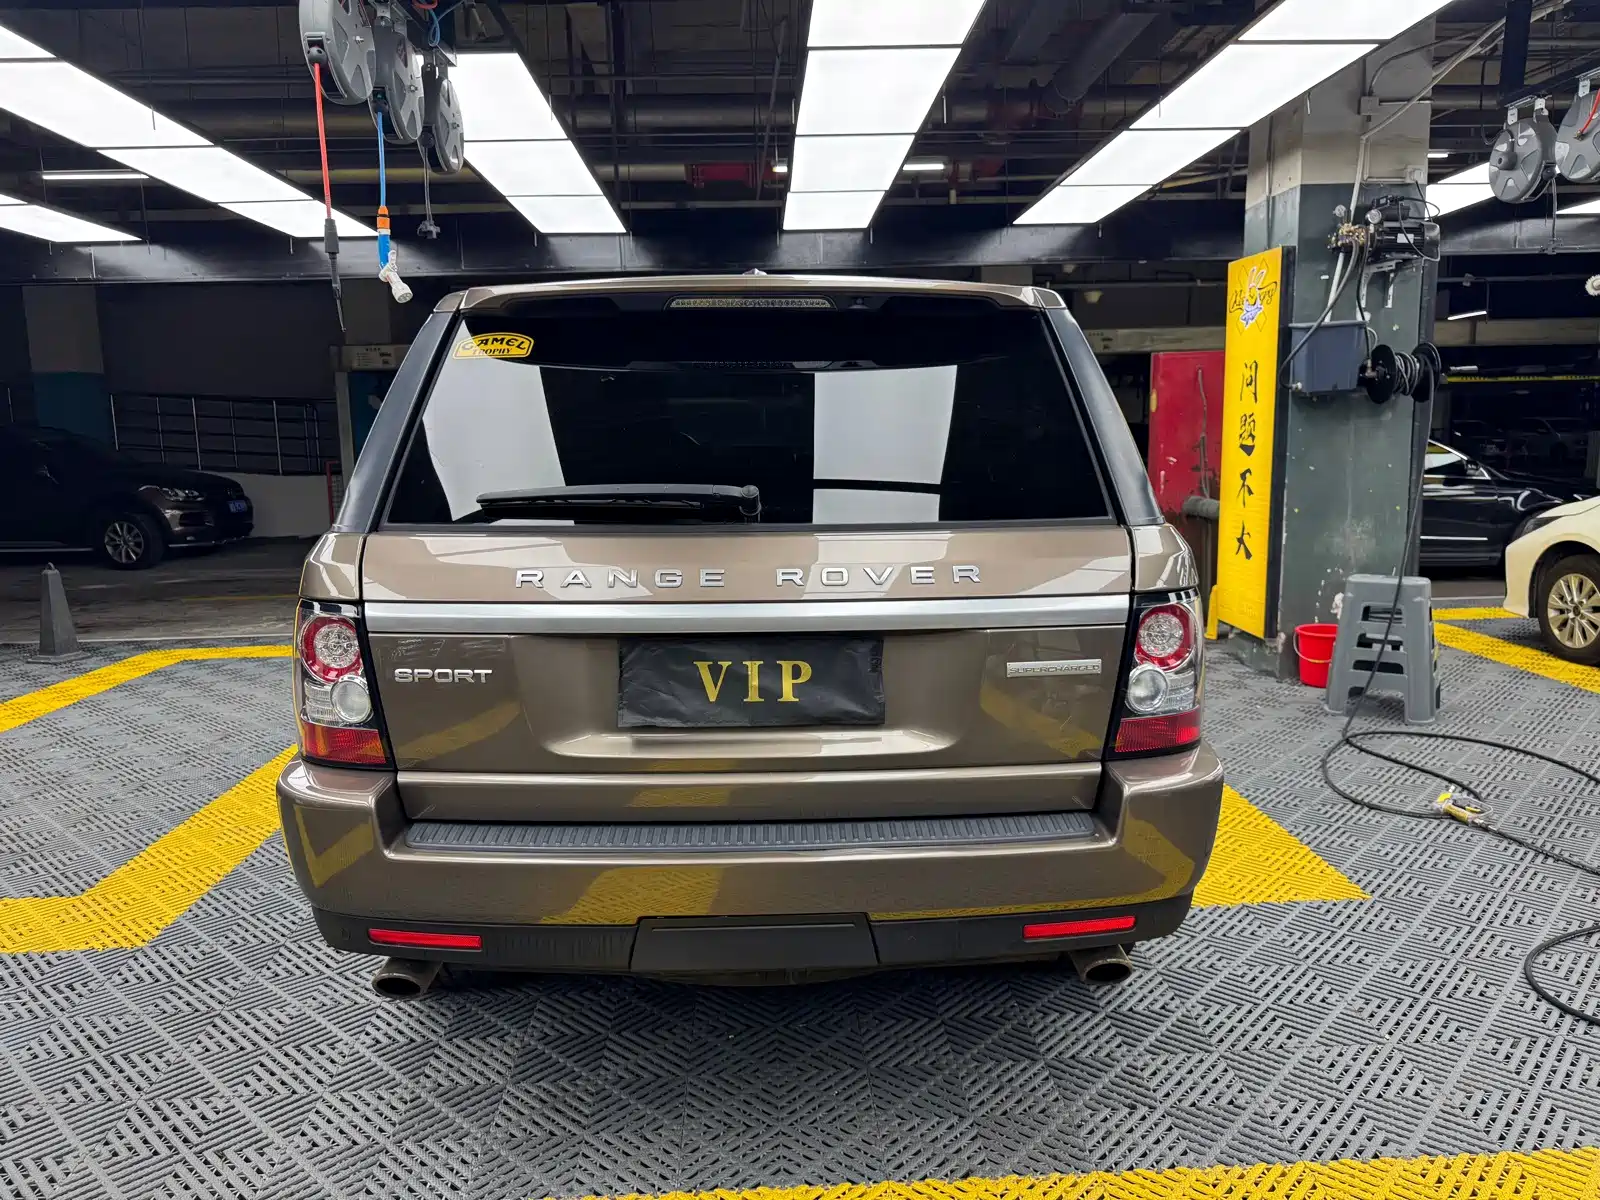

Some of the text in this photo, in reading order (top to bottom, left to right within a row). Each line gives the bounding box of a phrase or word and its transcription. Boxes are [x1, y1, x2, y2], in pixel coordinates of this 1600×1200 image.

[461, 337, 526, 350] CAMEL
[472, 347, 512, 356] TROPHY
[515, 565, 981, 589] RANGE ROVER
[394, 668, 493, 683] SPORT
[1008, 664, 1101, 675] SUPERCHARGED
[693, 660, 813, 703] VIP
